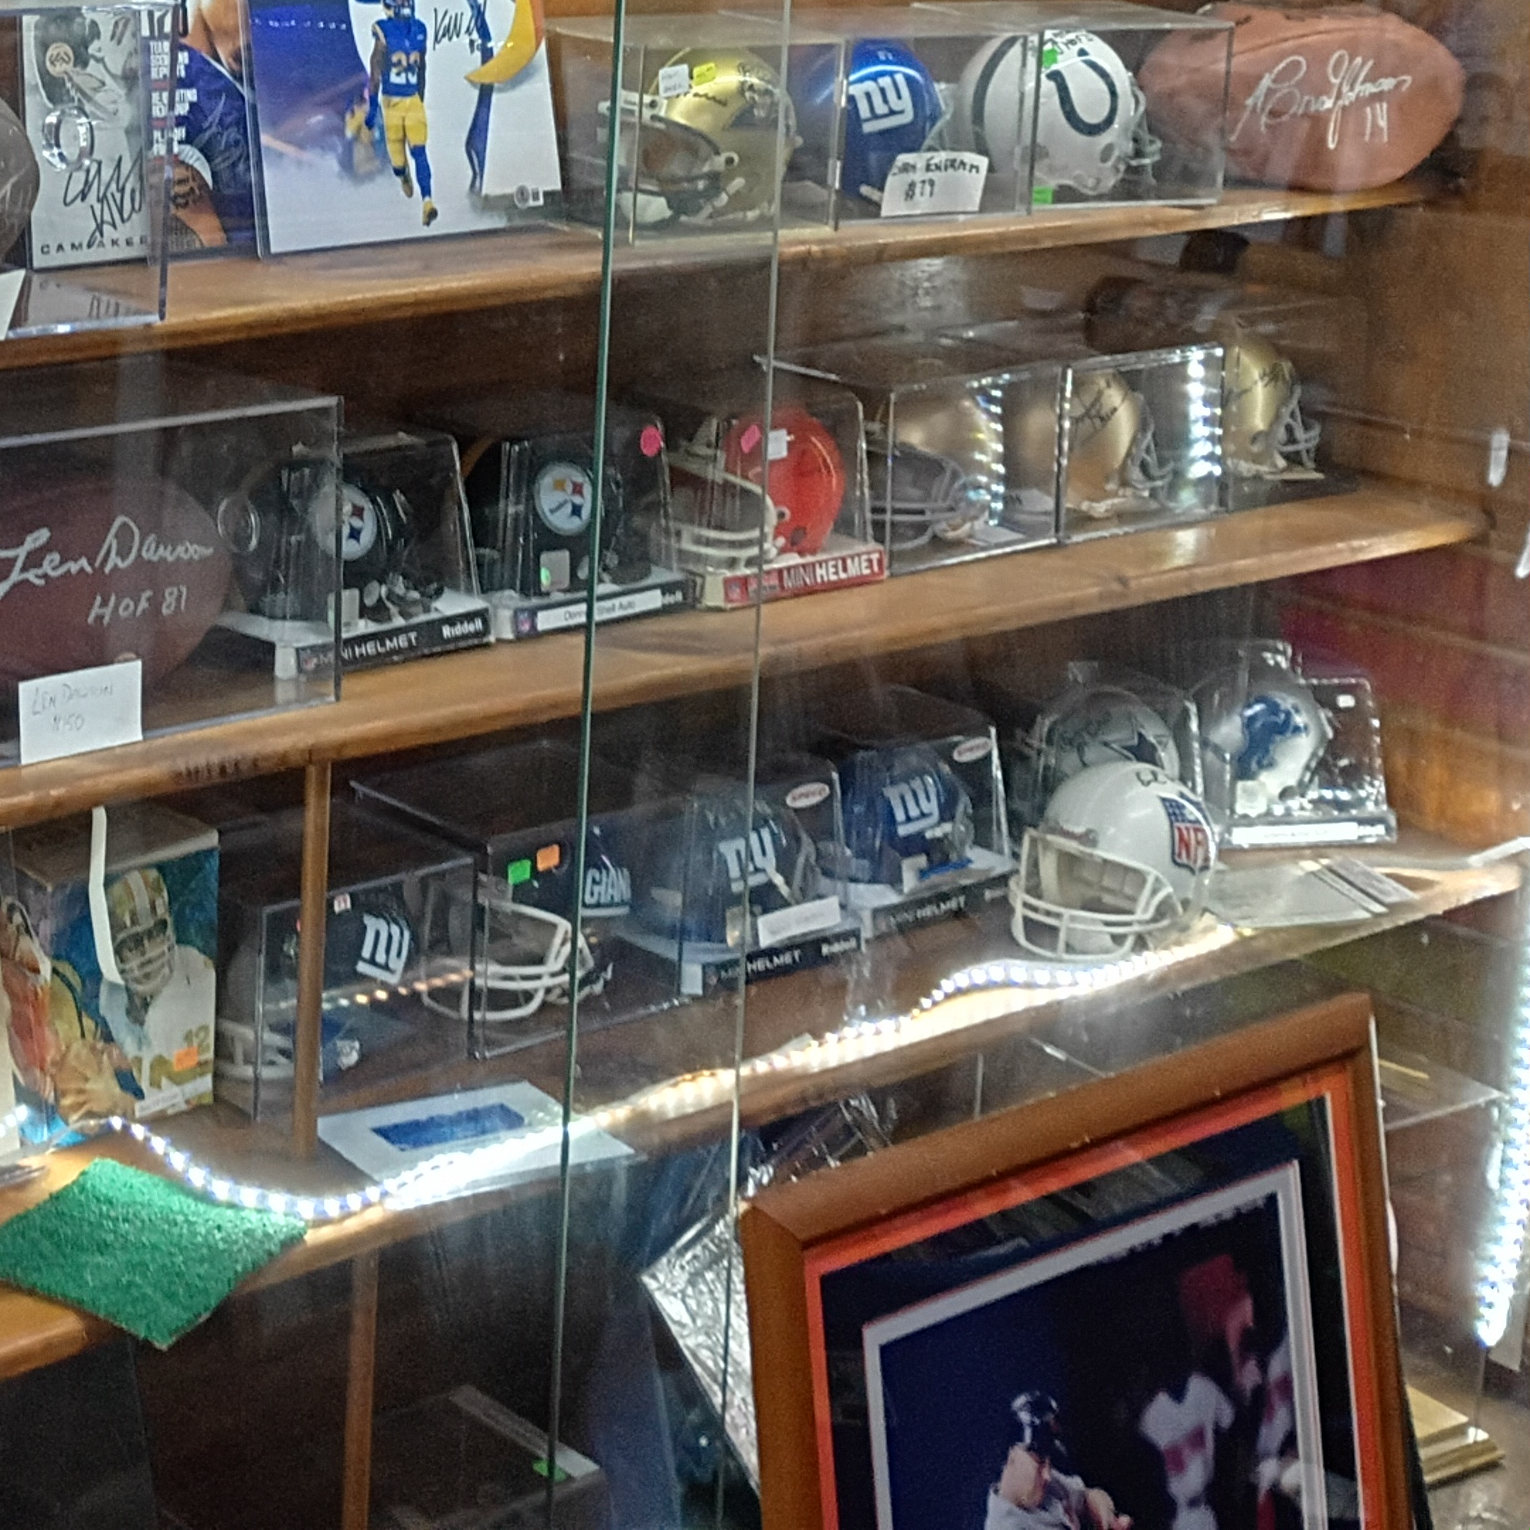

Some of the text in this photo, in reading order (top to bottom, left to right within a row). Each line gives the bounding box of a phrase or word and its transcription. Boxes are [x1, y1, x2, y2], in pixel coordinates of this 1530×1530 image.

[1364, 102, 1389, 144] 14
[40, 234, 160, 255] CAM AKER
[782, 566, 814, 589] MINI
[815, 553, 881, 583] HELMET
[87, 587, 151, 627] HOF
[354, 631, 418, 659] HELMET
[442, 617, 483, 640] Riddell
[747, 949, 803, 972] HELMET
